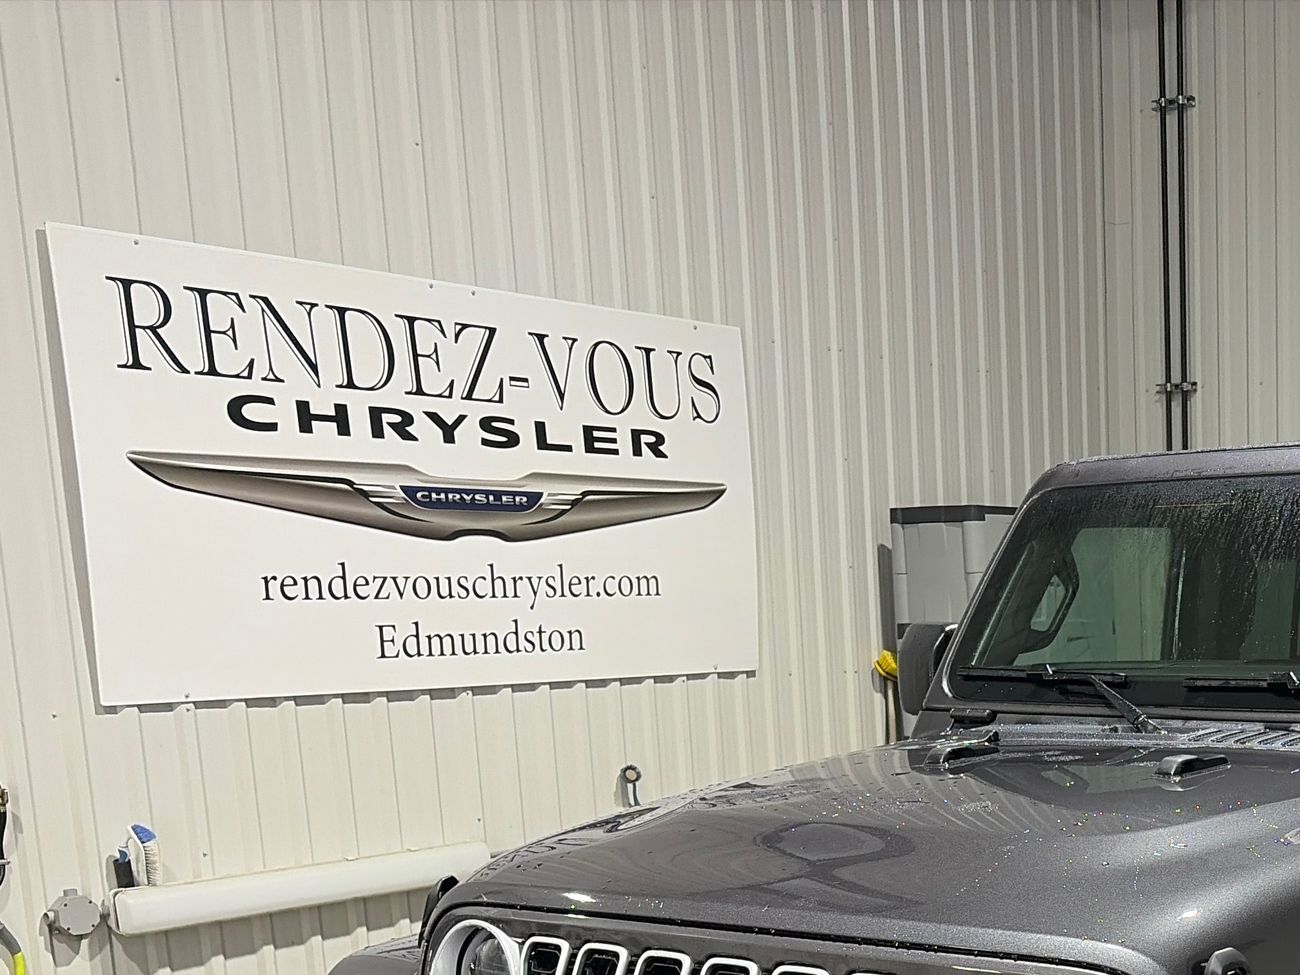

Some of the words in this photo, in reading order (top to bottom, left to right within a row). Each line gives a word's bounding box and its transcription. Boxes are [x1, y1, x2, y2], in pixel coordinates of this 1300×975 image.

[104, 275, 722, 424] RENDEZ-VOUS
[226, 394, 670, 459] CHRYSLER
[415, 490, 529, 506] CHRYSLER
[260, 562, 662, 611] rendezvouschrysler.com
[375, 619, 586, 660] Edmundston
